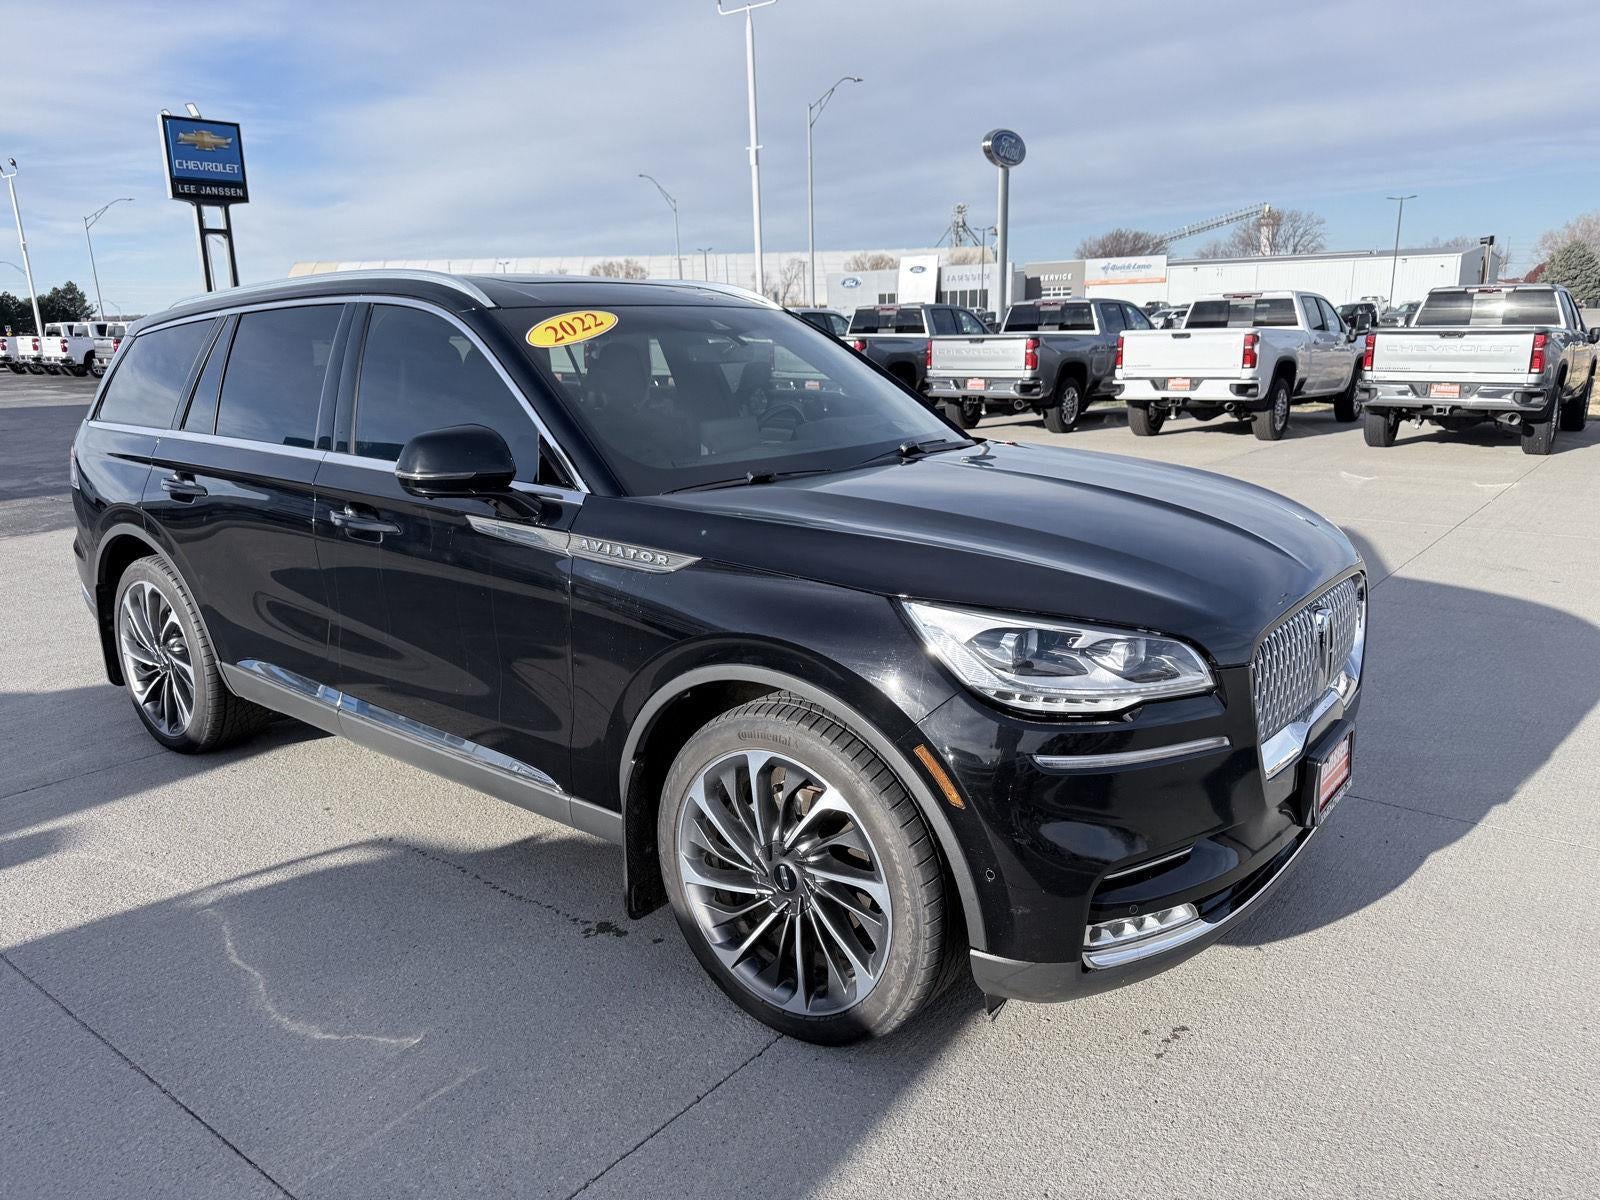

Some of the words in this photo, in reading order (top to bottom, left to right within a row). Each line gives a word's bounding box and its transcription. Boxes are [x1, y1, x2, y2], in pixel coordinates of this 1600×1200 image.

[175, 159, 239, 173] CHEVROLET
[178, 184, 197, 194] LEE
[200, 186, 244, 197] JANSSEN
[1040, 273, 1072, 281] SERVICE
[544, 313, 604, 343] 2022
[1386, 344, 1520, 353] CHEVROLET
[580, 538, 670, 566] AVIATOR
[738, 730, 792, 747] Continental
